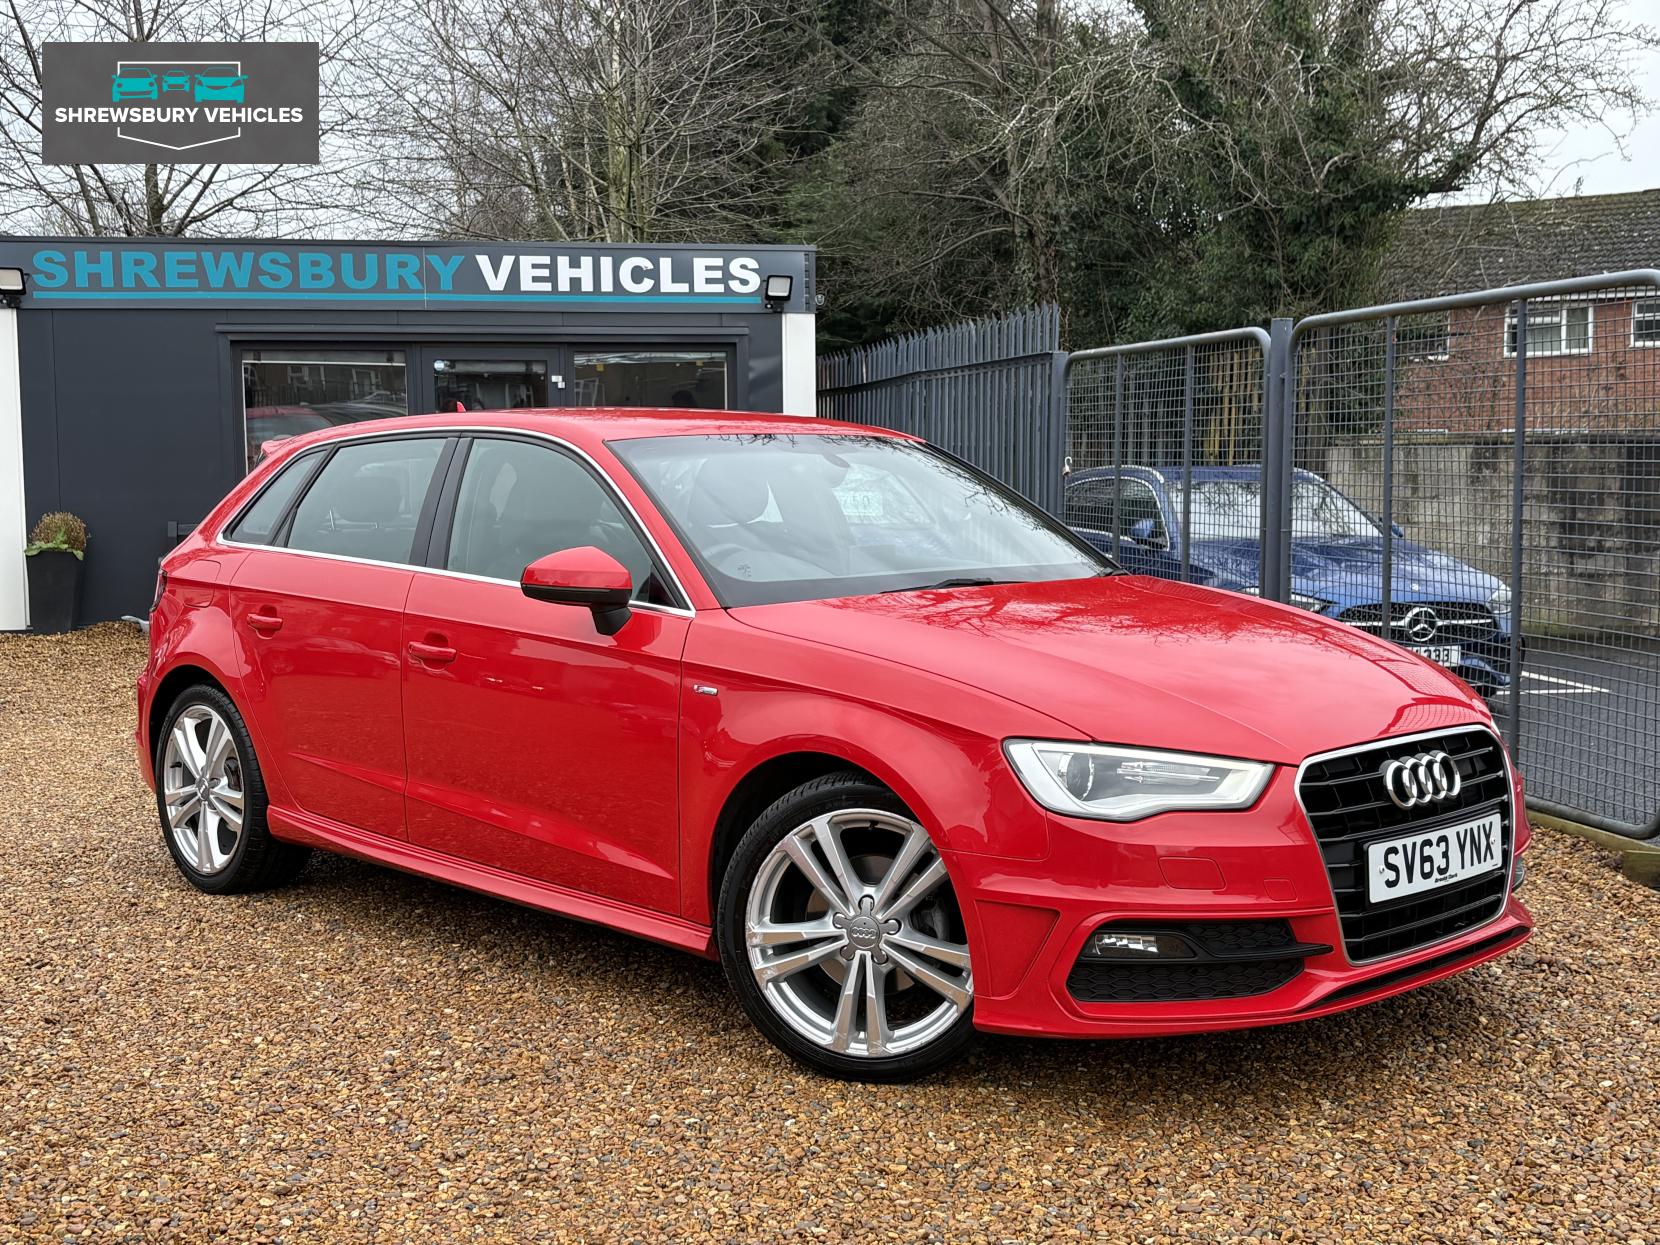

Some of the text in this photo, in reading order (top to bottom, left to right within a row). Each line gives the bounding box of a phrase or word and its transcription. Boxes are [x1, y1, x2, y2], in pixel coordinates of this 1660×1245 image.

[32, 250, 761, 292] SHREWSBURY VEHICLES
[1384, 821, 1494, 889] SV63 YNX
